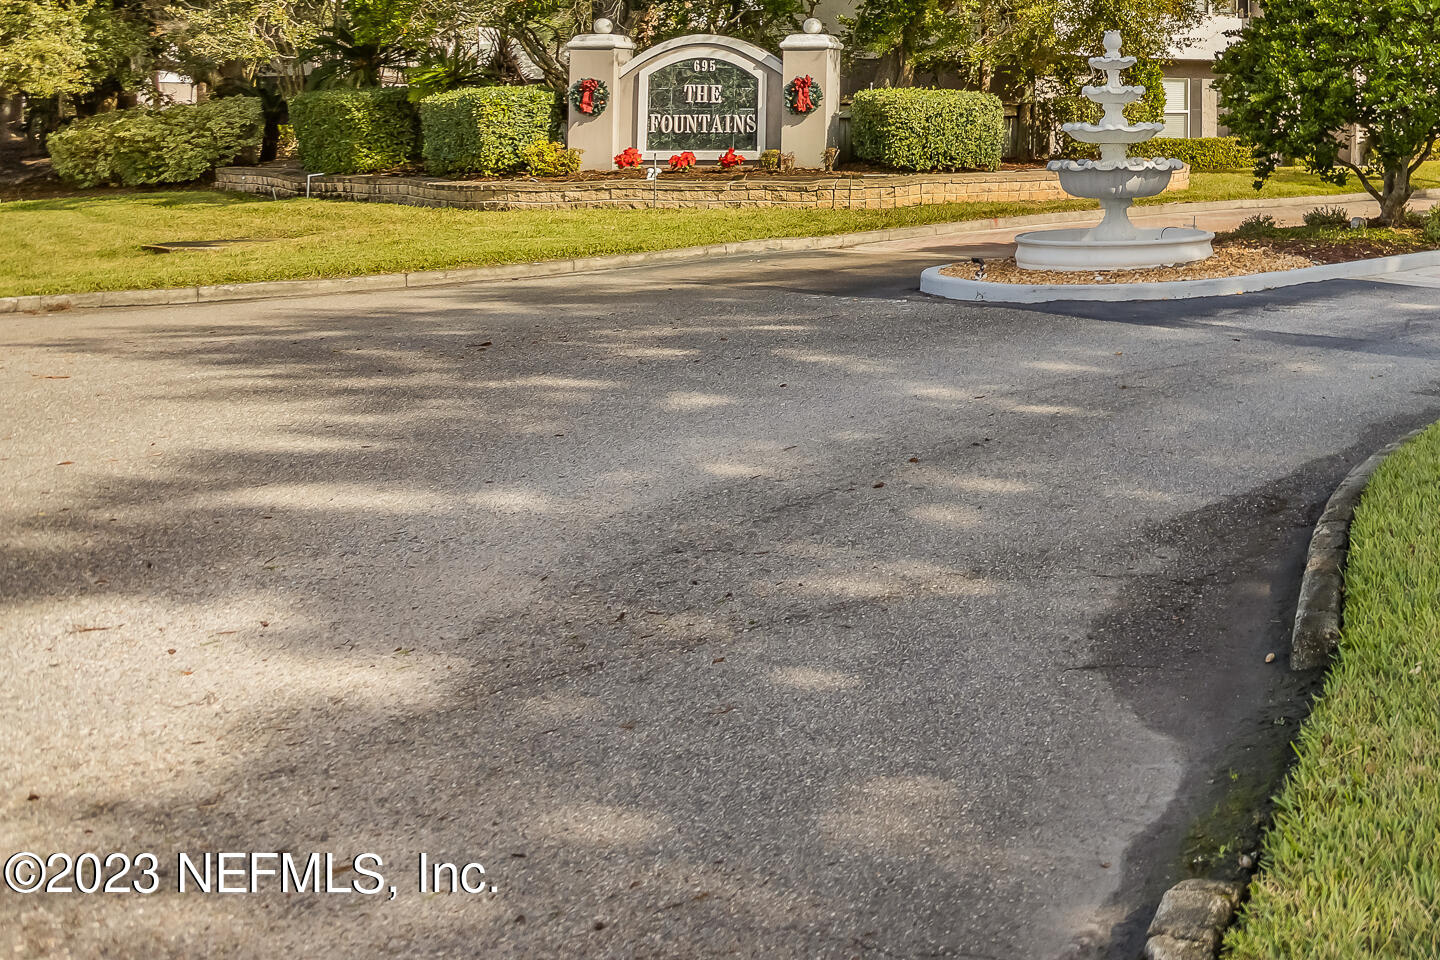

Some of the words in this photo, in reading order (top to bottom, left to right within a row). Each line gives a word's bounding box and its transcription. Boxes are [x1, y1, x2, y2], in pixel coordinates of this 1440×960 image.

[694, 59, 716, 72] 695
[684, 85, 722, 103] THE
[649, 114, 757, 133] FOUNTAINS
